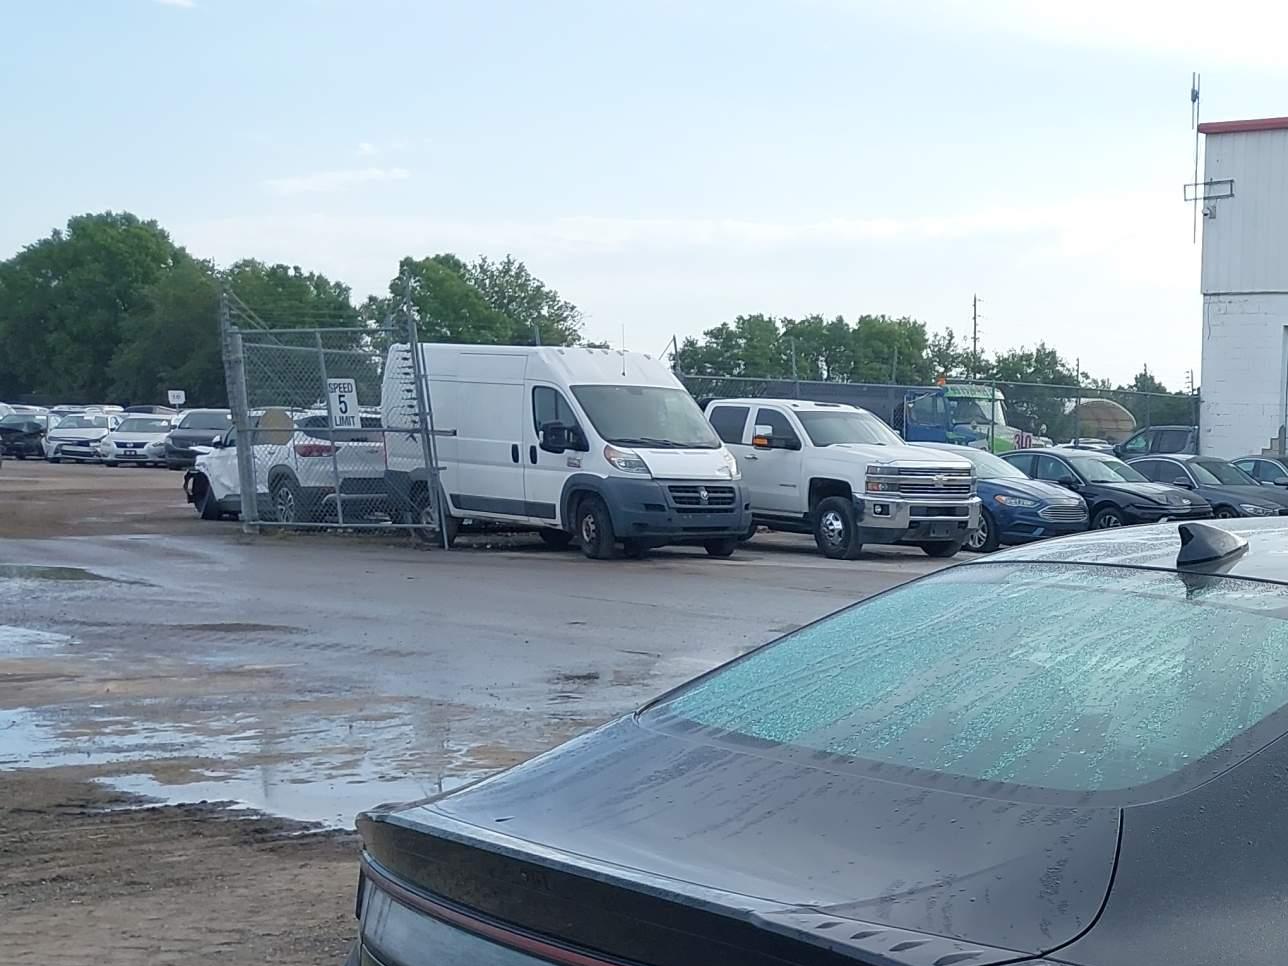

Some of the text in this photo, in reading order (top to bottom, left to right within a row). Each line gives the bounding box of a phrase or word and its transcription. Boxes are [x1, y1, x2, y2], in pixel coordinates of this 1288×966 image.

[328, 382, 353, 394] SPEED
[338, 394, 348, 414] 5
[334, 416, 355, 427] LIMIT
